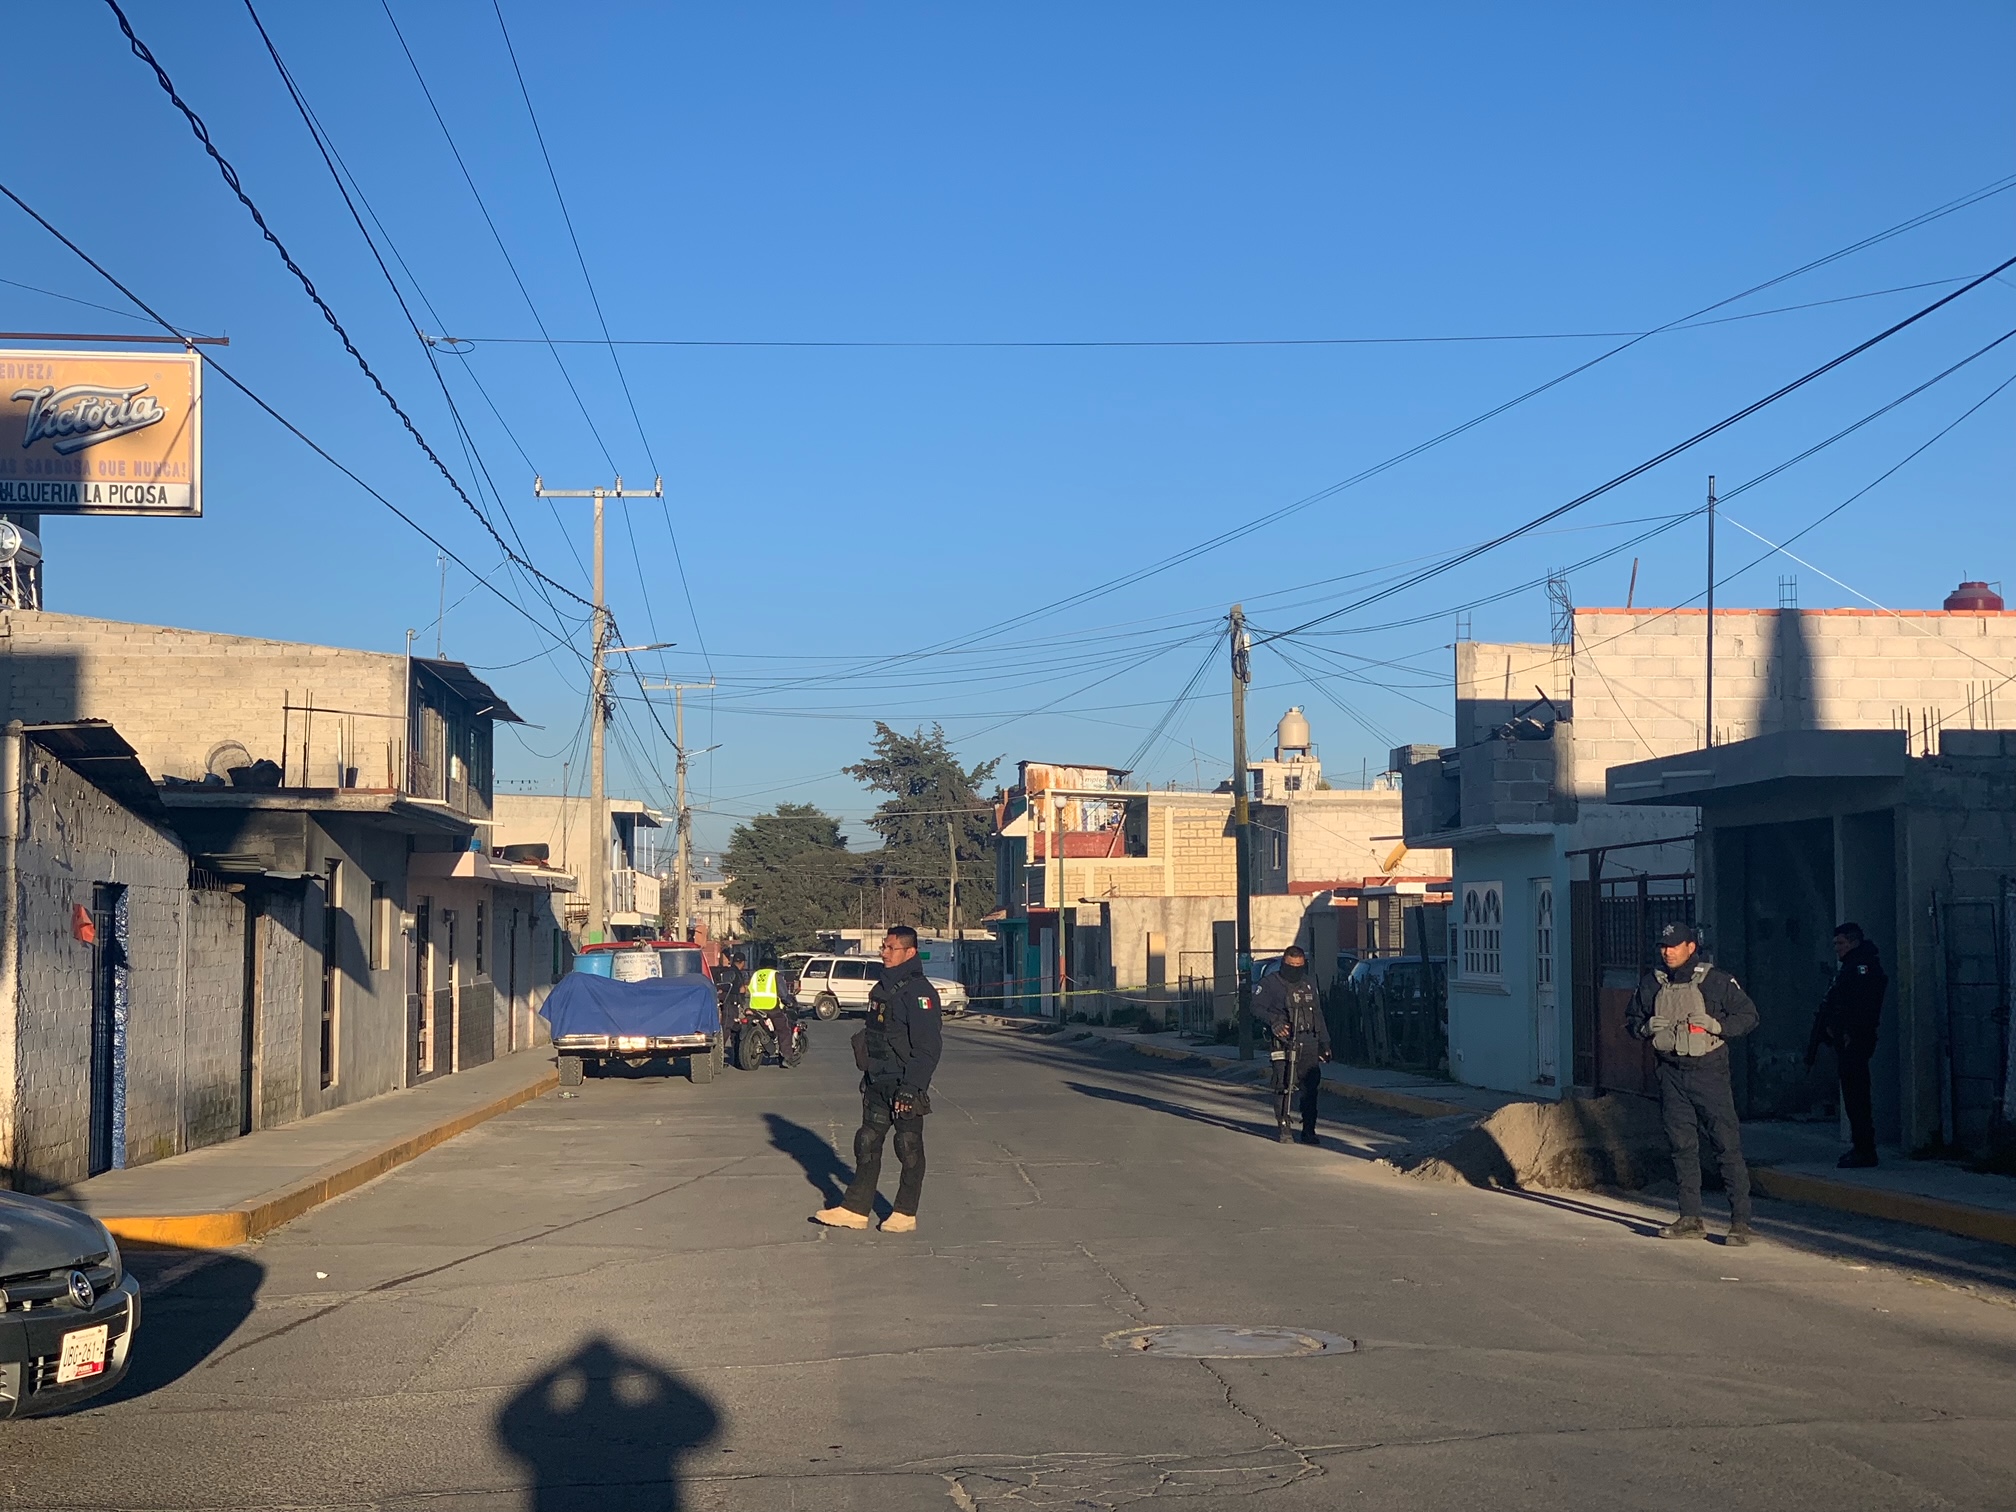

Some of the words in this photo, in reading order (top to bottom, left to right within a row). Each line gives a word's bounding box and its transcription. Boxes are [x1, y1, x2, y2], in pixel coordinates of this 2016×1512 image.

[10, 383, 165, 455] Victoria
[24, 459, 91, 476] SABROSA
[99, 460, 126, 476] QUE
[134, 460, 187, 477] NUNCA!
[83, 484, 102, 503] LA
[109, 484, 168, 504] PICOSA
